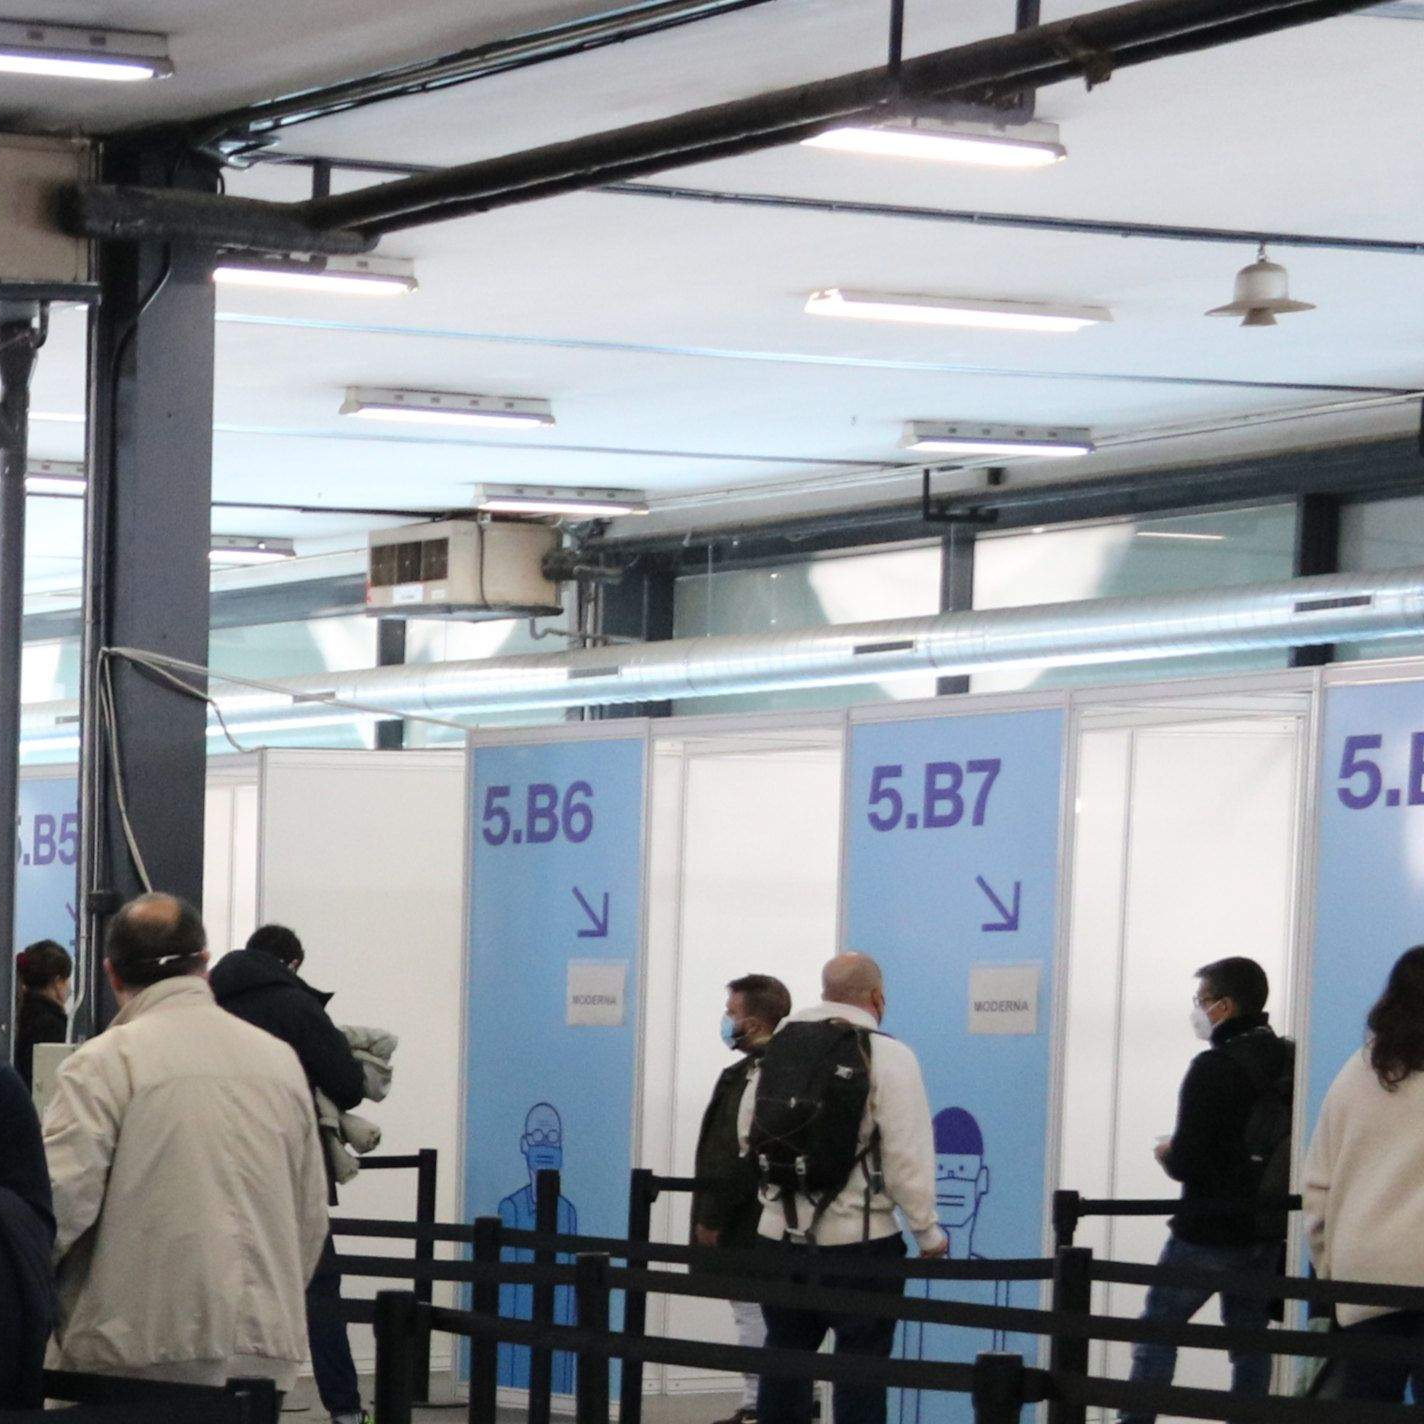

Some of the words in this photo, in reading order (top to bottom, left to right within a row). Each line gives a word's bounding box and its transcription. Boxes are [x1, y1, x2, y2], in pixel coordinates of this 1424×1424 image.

[483, 782, 593, 846] 5.B6
[868, 760, 1001, 831] 5.B7
[16, 813, 78, 866] .B5
[974, 1000, 1029, 1012] MODERNA
